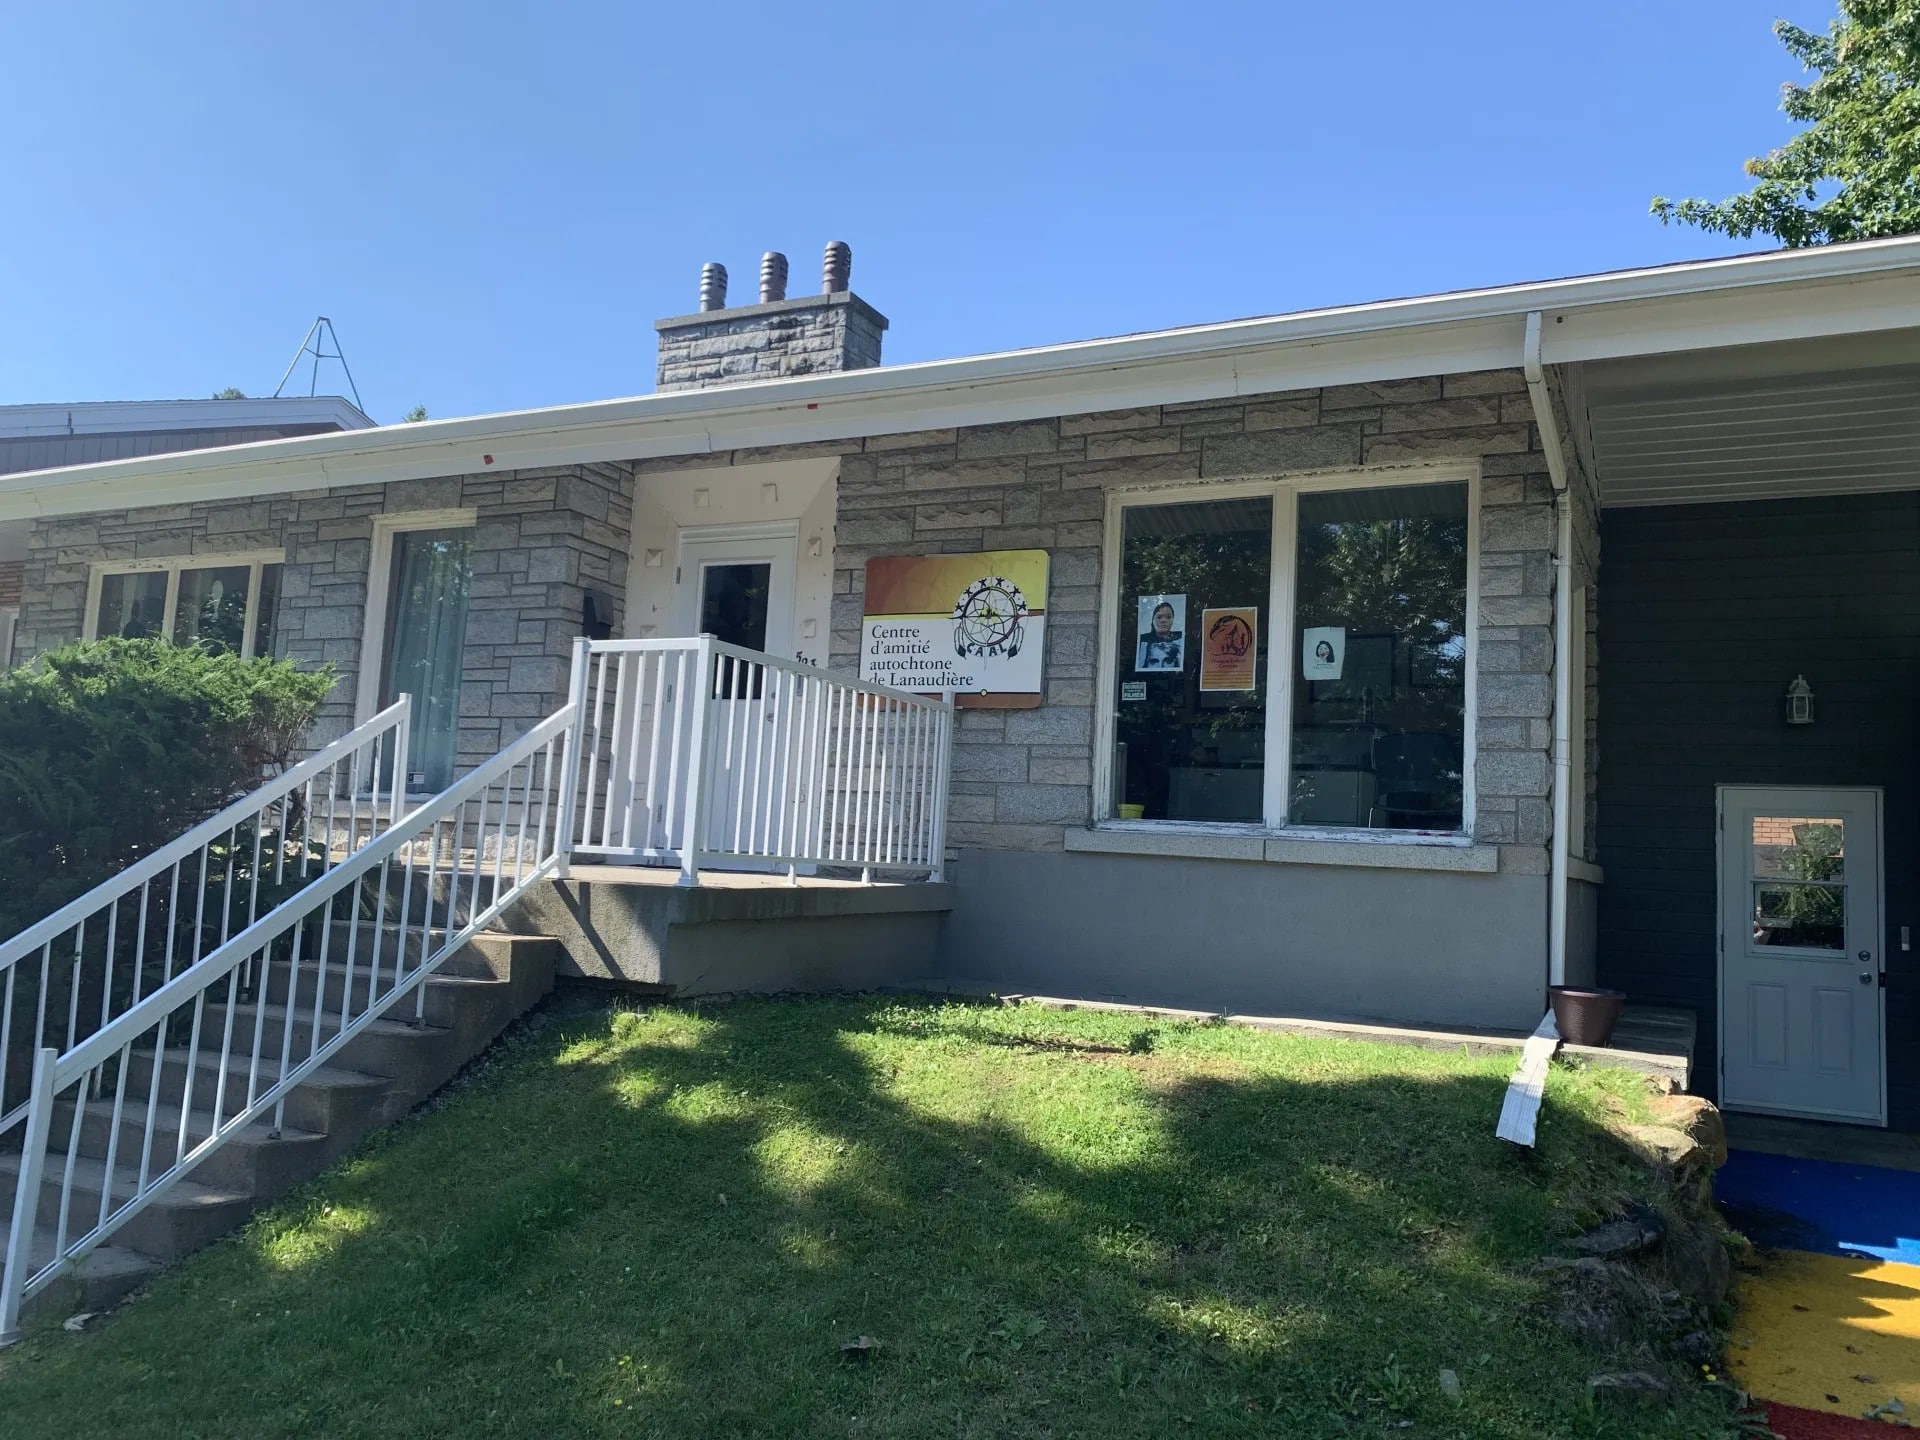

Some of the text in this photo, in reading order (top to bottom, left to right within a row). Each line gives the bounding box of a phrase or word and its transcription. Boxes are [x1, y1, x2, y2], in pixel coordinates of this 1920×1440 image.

[872, 625, 920, 638] Centre
[870, 640, 930, 654] d'amitié
[869, 656, 952, 670] autochtone
[869, 672, 974, 686] de Lanaudière
